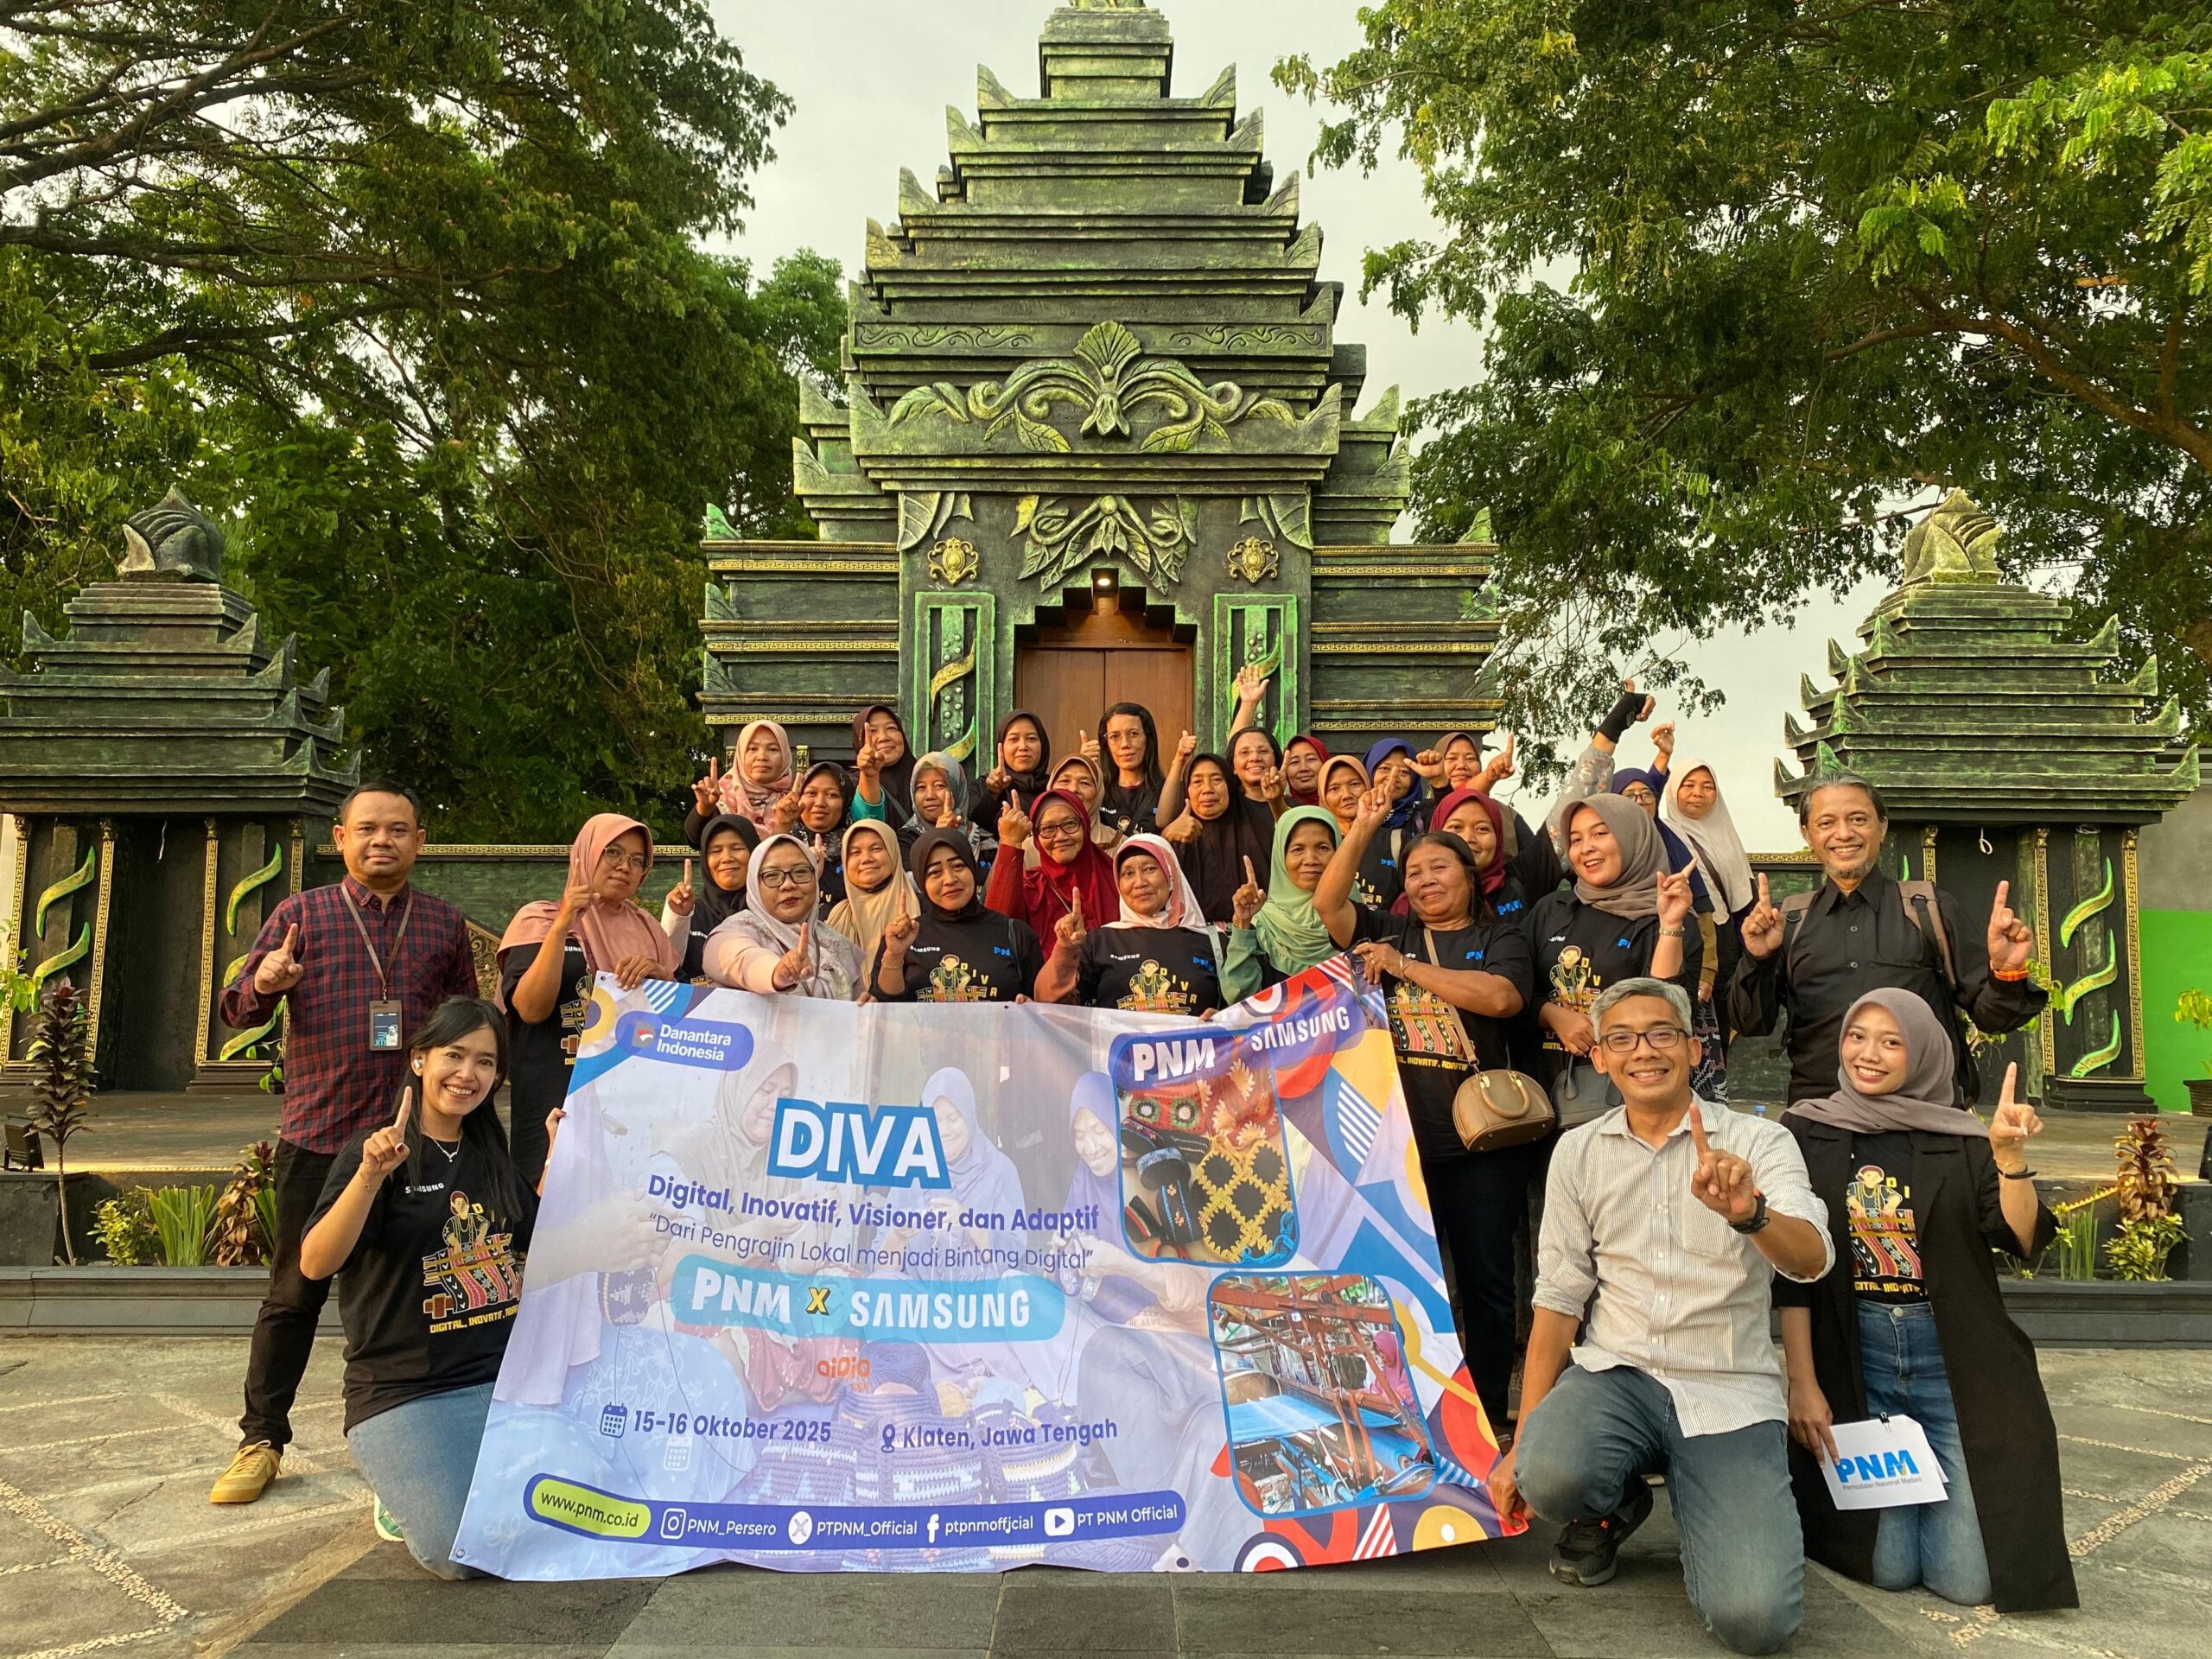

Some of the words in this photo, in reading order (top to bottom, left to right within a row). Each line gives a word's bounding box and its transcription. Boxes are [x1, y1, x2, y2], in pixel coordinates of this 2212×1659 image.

[993, 946, 1011, 957] PN
[1465, 950, 1484, 960] PN
[660, 1024, 732, 1046] Danantara
[1251, 1007, 1351, 1052] SAMSUNG
[657, 1039, 725, 1061] Indonesia
[1132, 1039, 1216, 1081] PNM
[775, 1107, 942, 1179] DIVA
[648, 1174, 734, 1215] Digital,
[741, 1192, 842, 1228] Inovatif,
[849, 1202, 953, 1232] Visioner,
[958, 1208, 1005, 1230] dan
[1011, 1204, 1099, 1238] Adaptif
[701, 1226, 795, 1262] Pengrajin
[800, 1241, 851, 1263] Lokal
[856, 1247, 939, 1272] menjadi
[944, 1247, 1020, 1268] Bintang
[691, 1267, 791, 1324] PNM
[849, 1289, 1030, 1329] SAMSUNG
[634, 1410, 687, 1434] 15-16
[693, 1414, 779, 1440] Oktober
[782, 1420, 832, 1442] 2025
[903, 1426, 976, 1450] Klaten,
[982, 1427, 1035, 1446] Jawa
[1040, 1418, 1118, 1446] Tengah
[1834, 1449, 1920, 1484] PNM
[541, 1492, 639, 1528] www.pnm.co.id
[1077, 1513, 1094, 1527] PT
[1096, 1510, 1128, 1526] PNM
[1131, 1503, 1178, 1522] Official
[687, 1519, 777, 1536] PNM_Persero
[817, 1520, 918, 1537] PTPNM_Official
